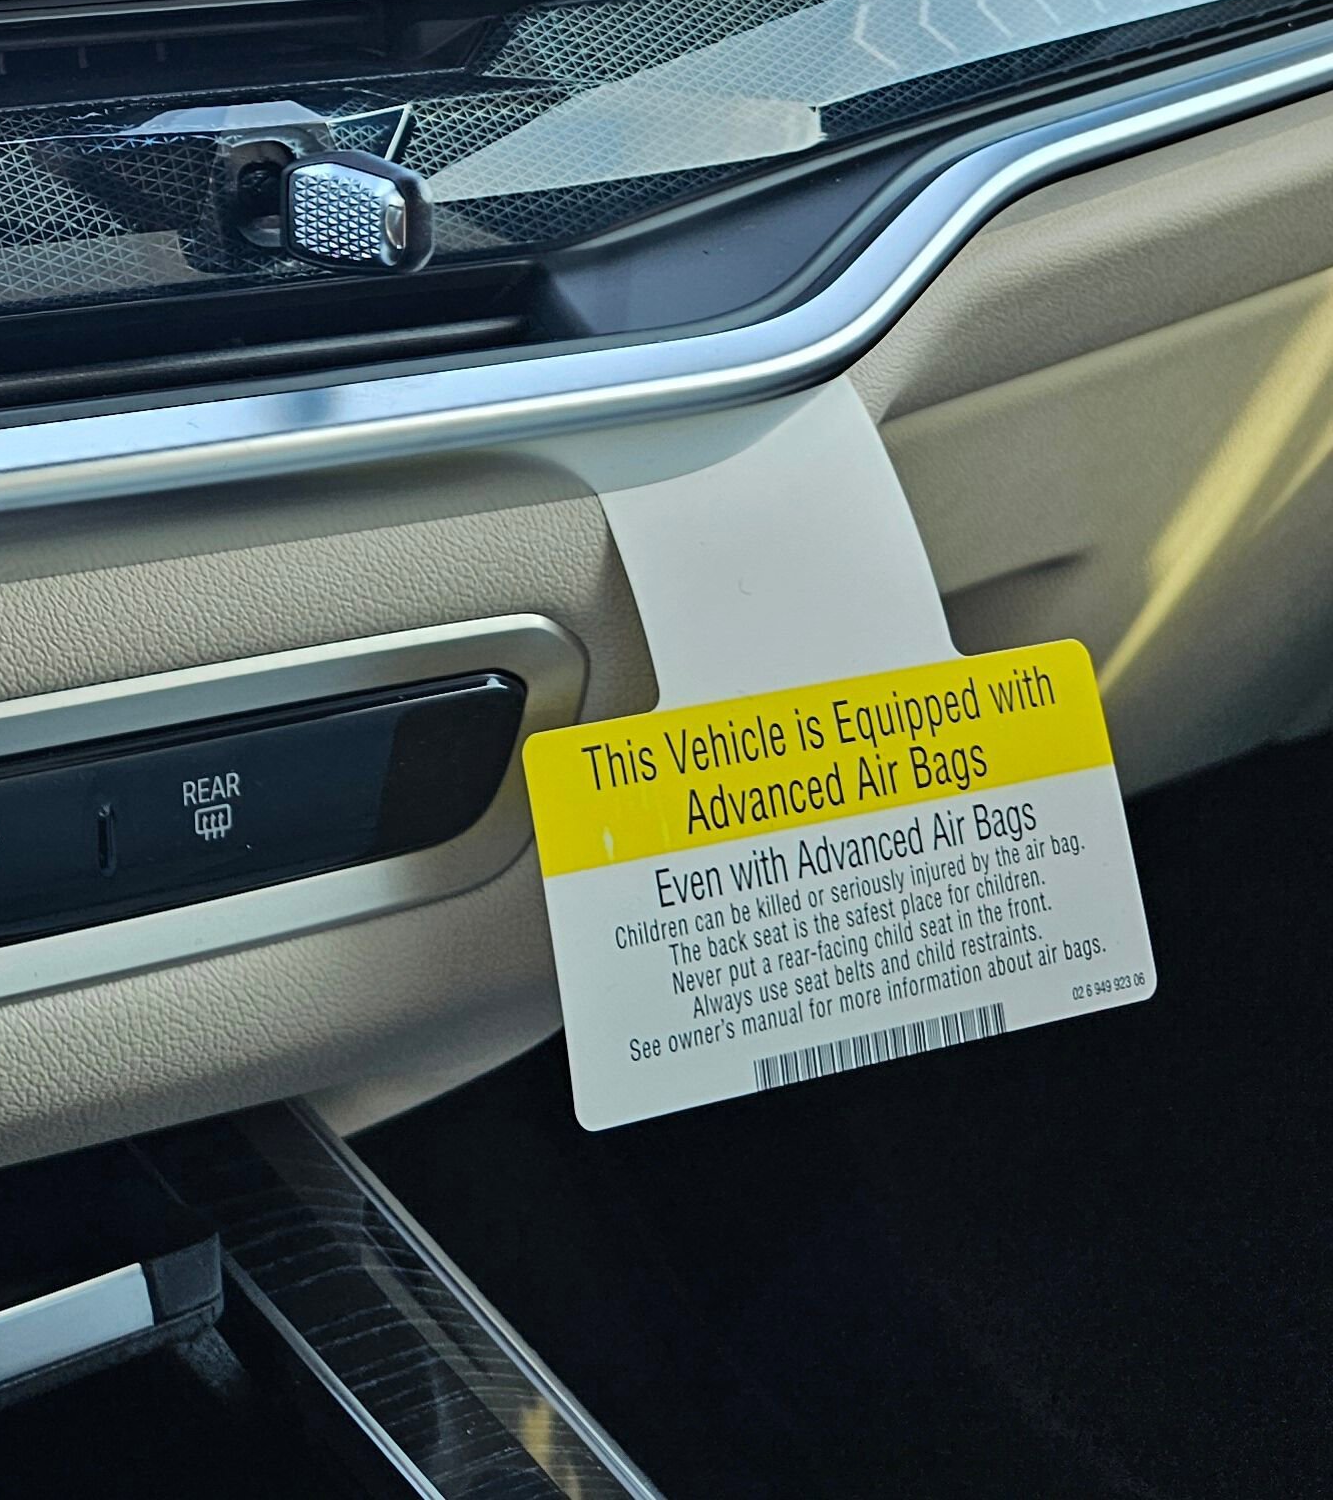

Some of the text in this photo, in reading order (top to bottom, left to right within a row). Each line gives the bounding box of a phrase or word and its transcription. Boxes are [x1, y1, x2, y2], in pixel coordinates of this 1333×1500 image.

[581, 666, 1055, 791] This Vehicle is Equipped with
[182, 772, 240, 806] REAR
[688, 745, 987, 834] Advanced Air Bags
[615, 835, 1085, 949] Children can be killed or seriously injured by the air bag.
[655, 803, 1036, 908] Even with Advanced Air Bags
[670, 870, 1045, 965] The back seat is the safest place for children.
[672, 892, 1051, 994] Never put a rear-facing child seat in the front.
[630, 938, 1106, 1061] See owner's manual for more information about air bags.
[693, 924, 1042, 1019] Always use seat belts and child restraints.
